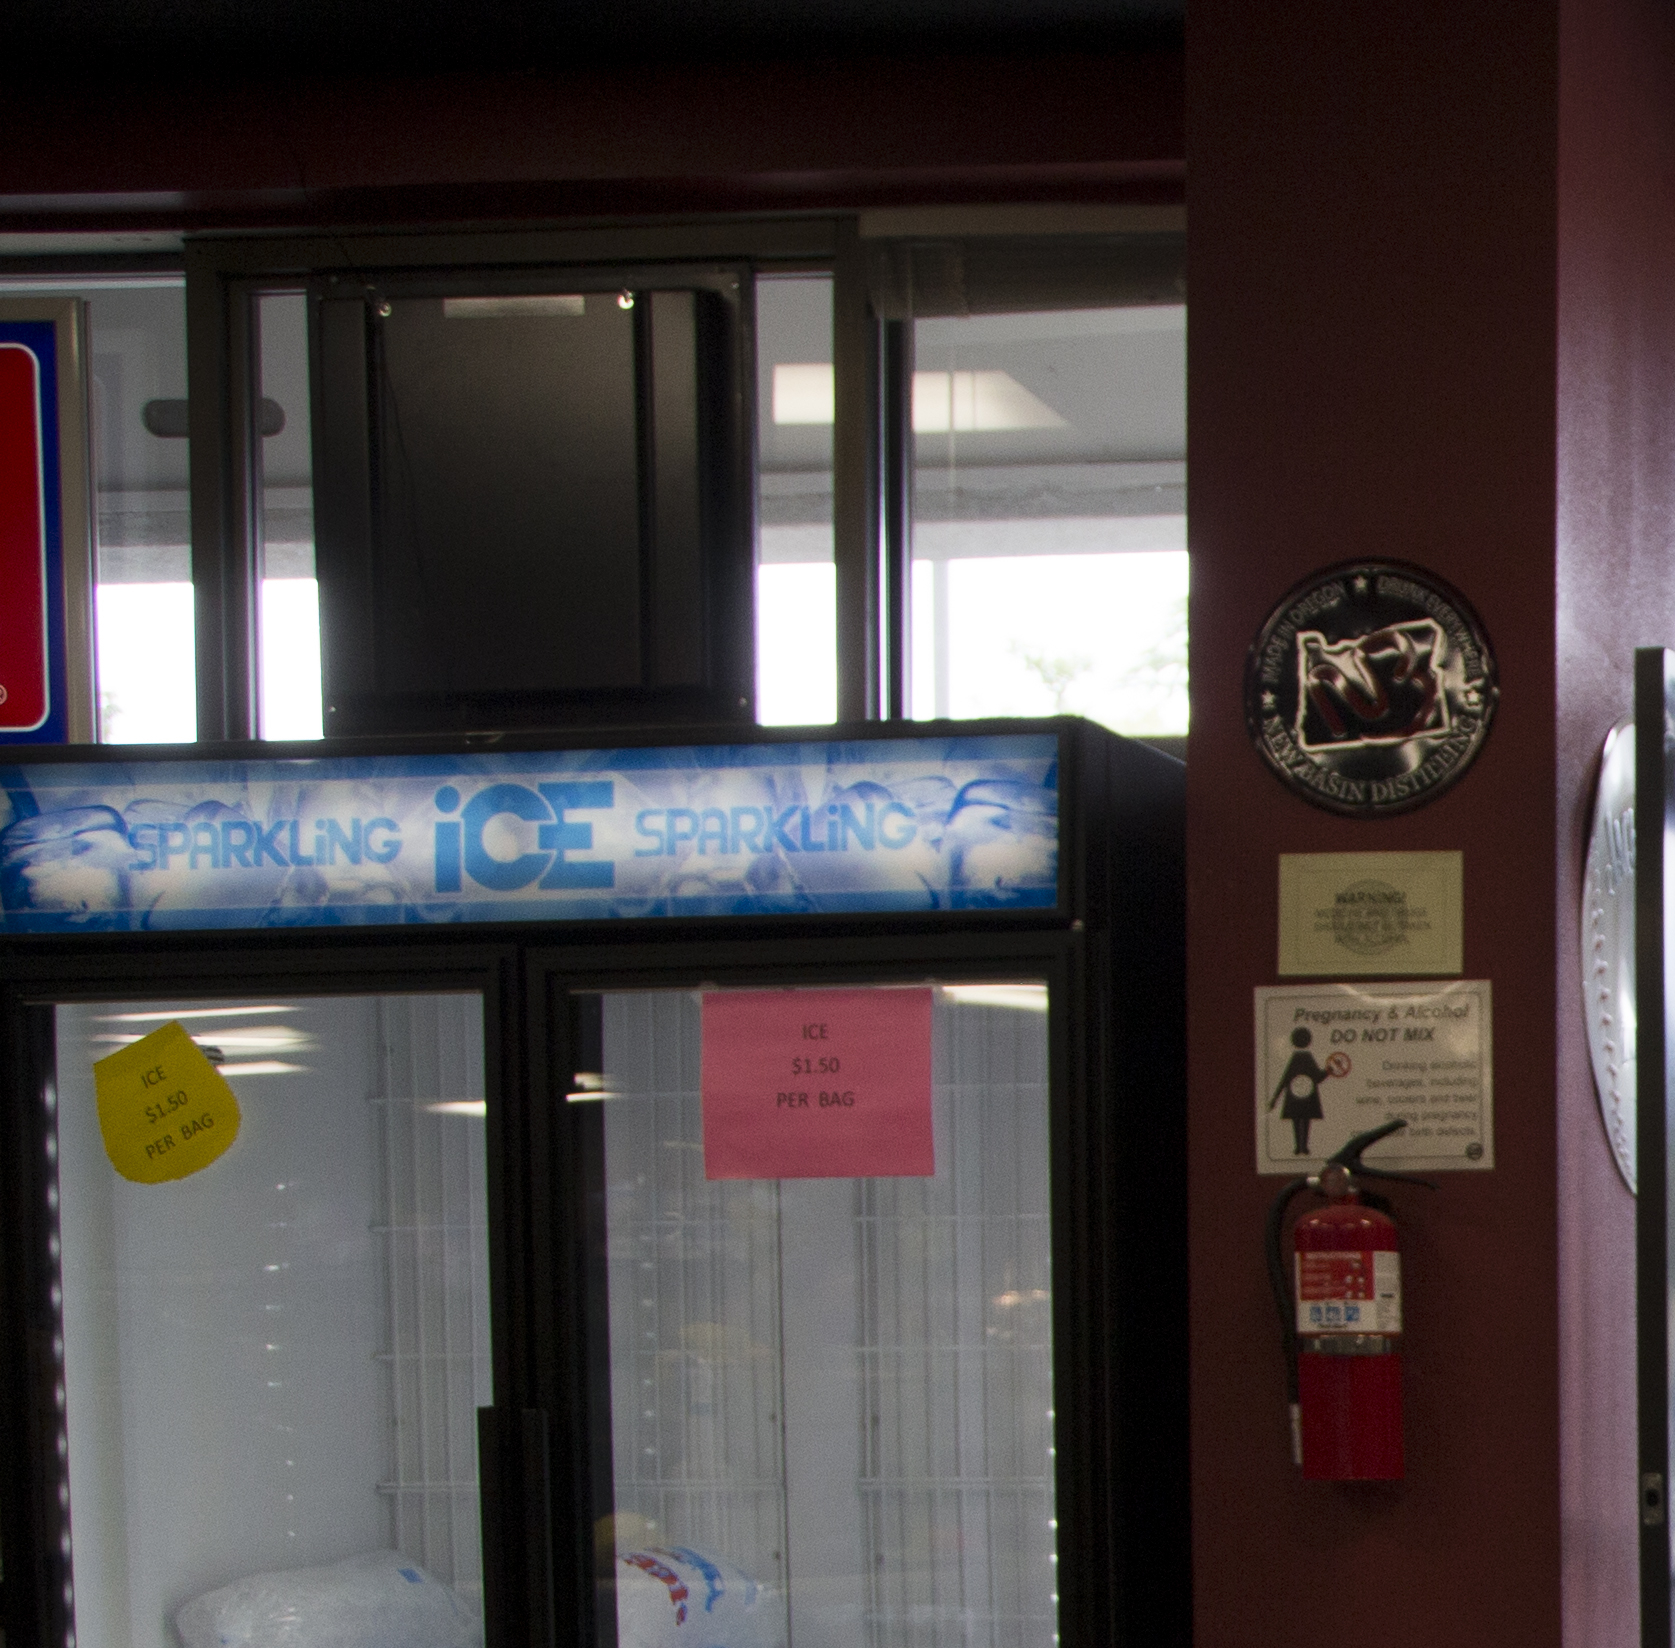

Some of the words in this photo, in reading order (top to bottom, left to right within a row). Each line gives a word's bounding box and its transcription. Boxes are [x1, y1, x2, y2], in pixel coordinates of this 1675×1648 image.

[1261, 635, 1288, 683] MADE
[1263, 714, 1304, 772] NEW
[1299, 763, 1366, 802] BASIN
[1371, 714, 1477, 802] DISTILLING
[1293, 1007, 1380, 1025] Pregnancy
[1387, 1006, 1398, 1020] &
[1405, 1004, 1469, 1020] Alcohol
[802, 1023, 828, 1040] ICE
[1330, 1029, 1357, 1044] DO
[1361, 1028, 1399, 1043] NOT
[1403, 1027, 1435, 1042] MIX
[792, 1057, 840, 1075] $1.50
[142, 1066, 167, 1089] ICE
[145, 1090, 188, 1124] $1.50
[776, 1091, 809, 1108] PER
[818, 1091, 855, 1108] BAG
[145, 1134, 176, 1160] PER
[180, 1112, 215, 1140] BAG
